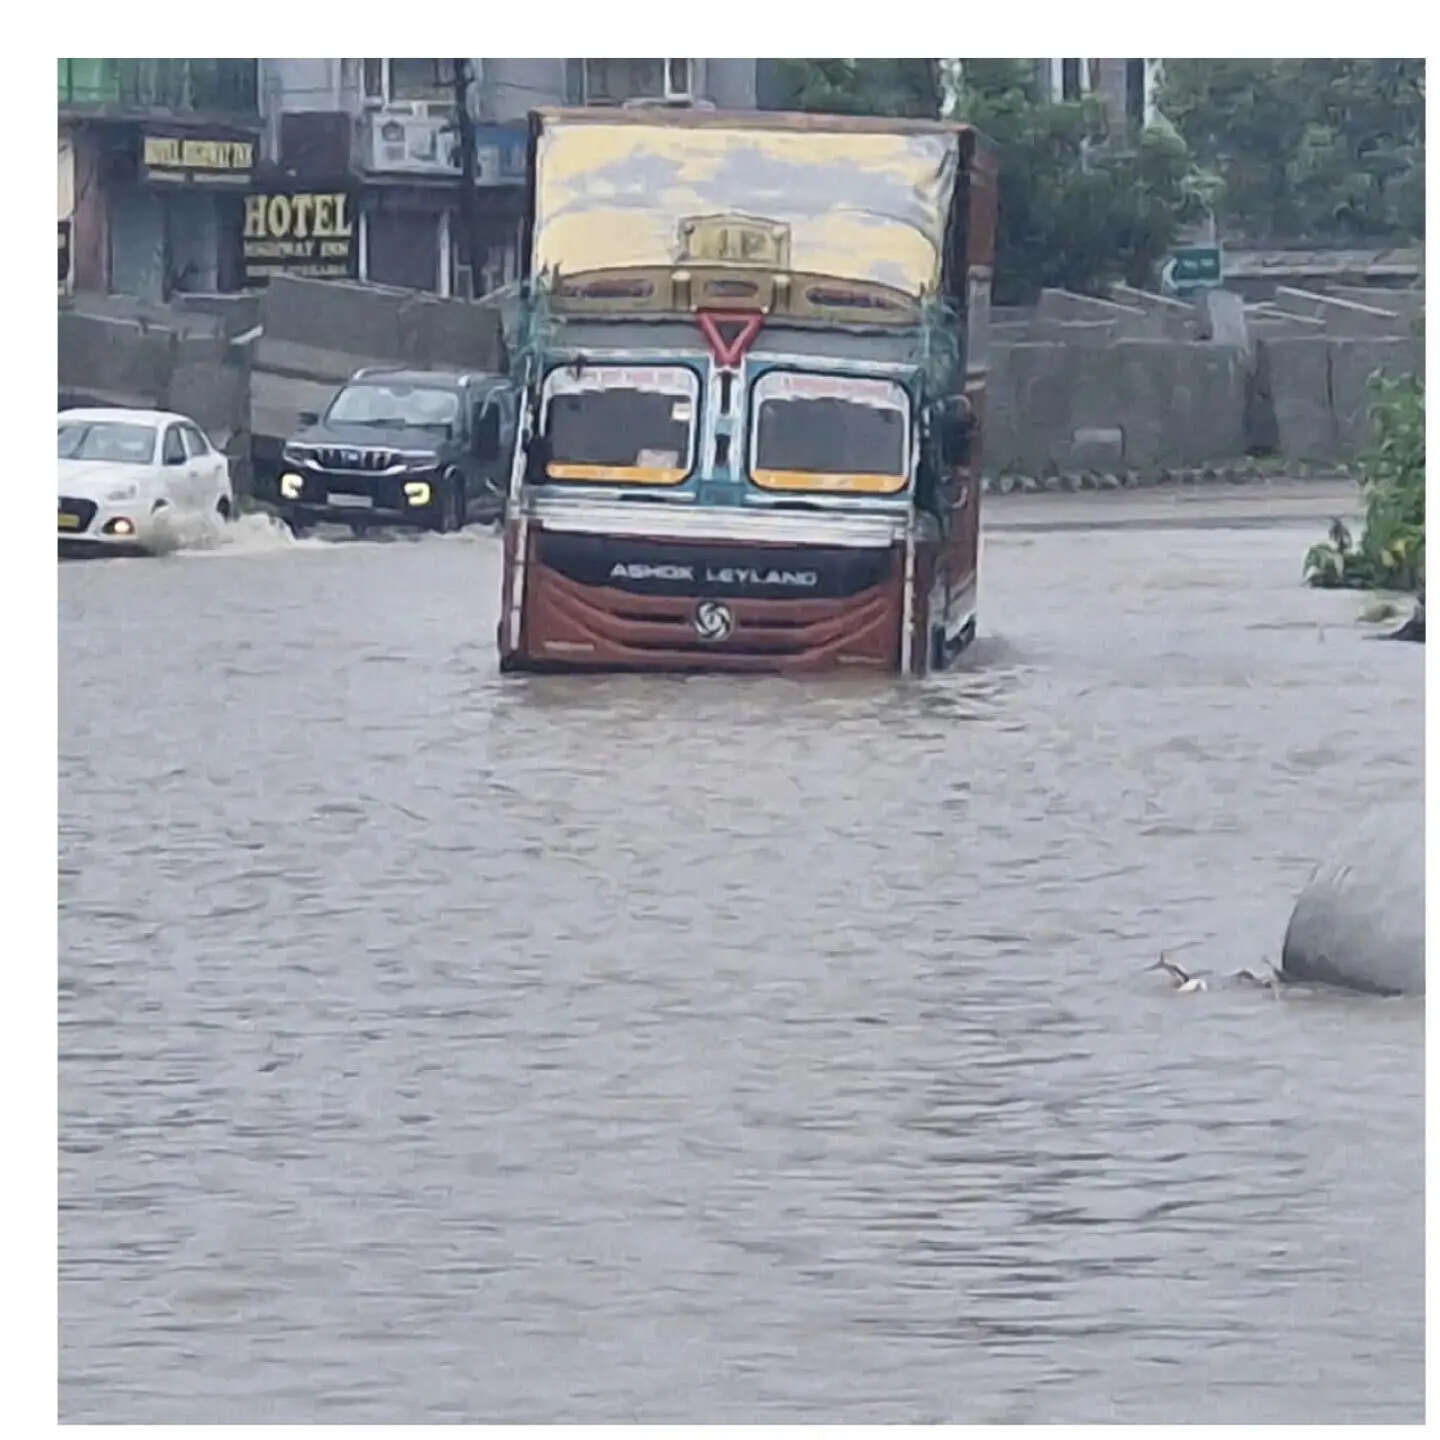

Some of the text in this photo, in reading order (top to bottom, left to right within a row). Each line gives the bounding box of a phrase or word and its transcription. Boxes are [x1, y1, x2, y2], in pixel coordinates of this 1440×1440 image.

[243, 193, 352, 238] HOTEL
[610, 563, 818, 587] ASHOK LEYLAND
